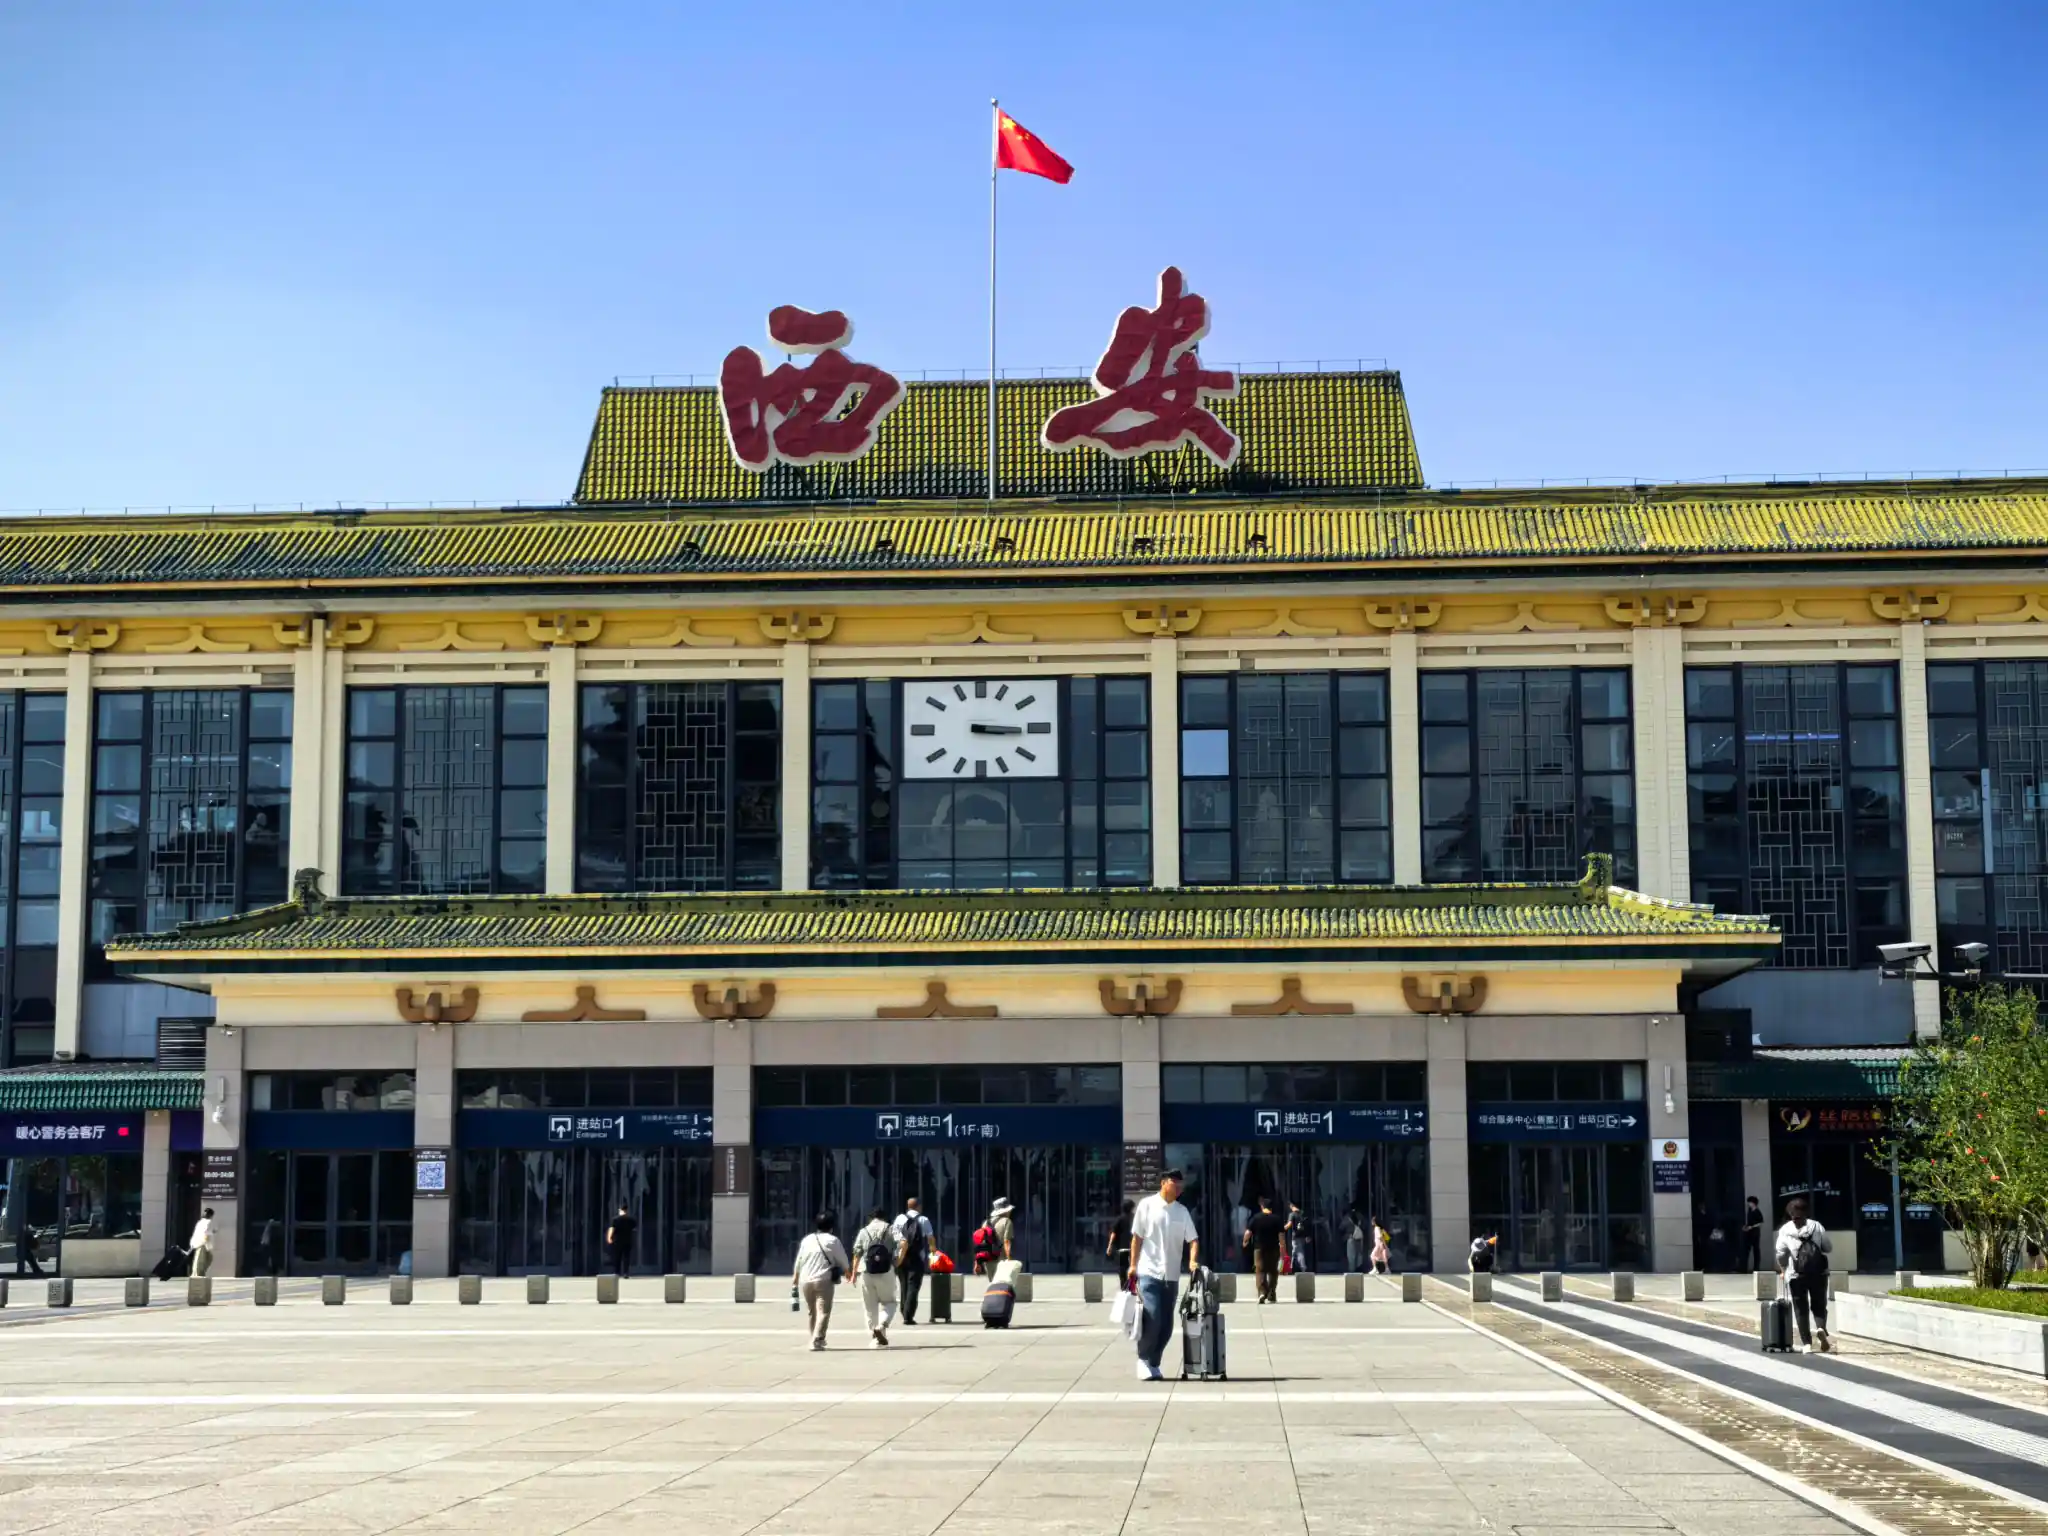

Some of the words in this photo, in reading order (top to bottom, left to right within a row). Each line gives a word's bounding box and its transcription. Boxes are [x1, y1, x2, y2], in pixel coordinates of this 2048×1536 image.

[717, 265, 1243, 474] 西安
[576, 1117, 612, 1130] 进站口
[615, 1116, 624, 1139] 1
[904, 1115, 940, 1127] 进站口
[942, 1113, 953, 1137] 1
[1284, 1112, 1320, 1124] 进站口
[1323, 1111, 1333, 1135] 1
[1578, 1114, 1605, 1124] 出站口
[15, 1125, 106, 1140] 暖心警务会客厅
[903, 1129, 936, 1137] Entrance
[1284, 1126, 1316, 1134] Entrance
